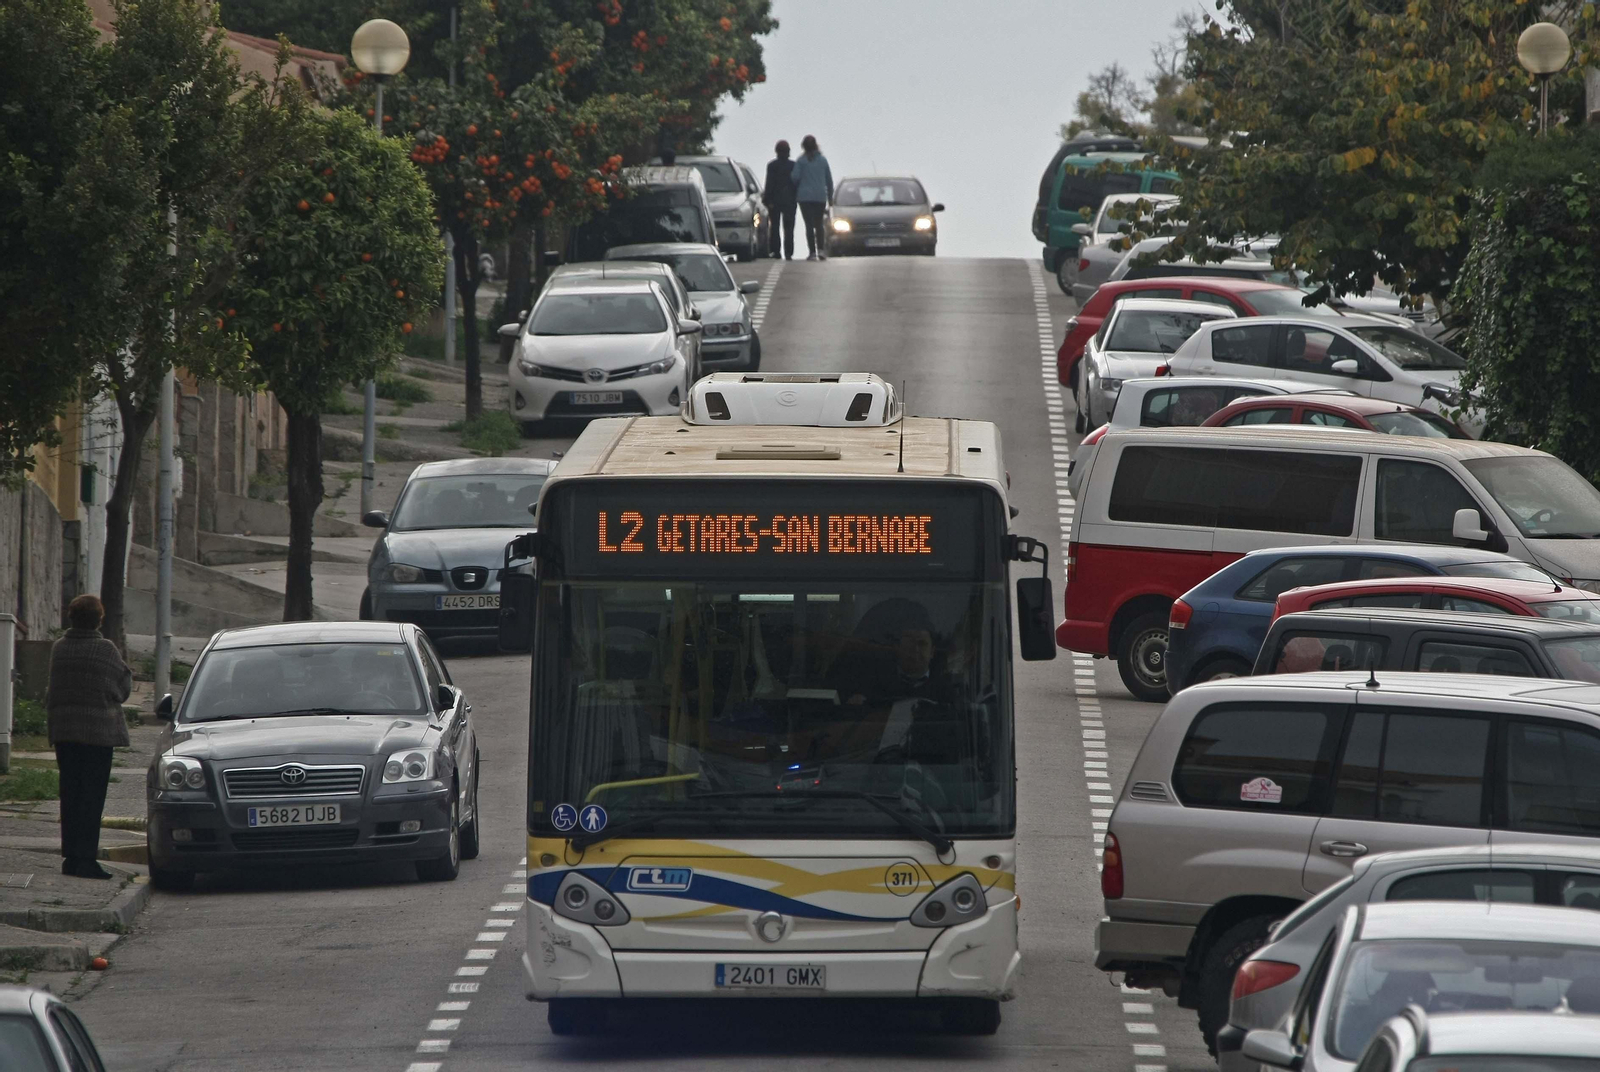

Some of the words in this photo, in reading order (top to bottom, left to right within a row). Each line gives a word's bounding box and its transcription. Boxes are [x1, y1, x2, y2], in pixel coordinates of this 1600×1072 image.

[576, 393, 600, 403] 7510
[598, 511, 644, 552] L2
[657, 514, 819, 553] GETARES-SAN
[828, 514, 932, 553] BERNABE
[444, 596, 475, 608] 4452
[478, 595, 500, 608] DRS
[259, 807, 300, 824] 5682
[305, 806, 336, 822] DJB
[892, 872, 912, 886] 371
[731, 966, 774, 985] 2401
[787, 968, 821, 986] GMX
